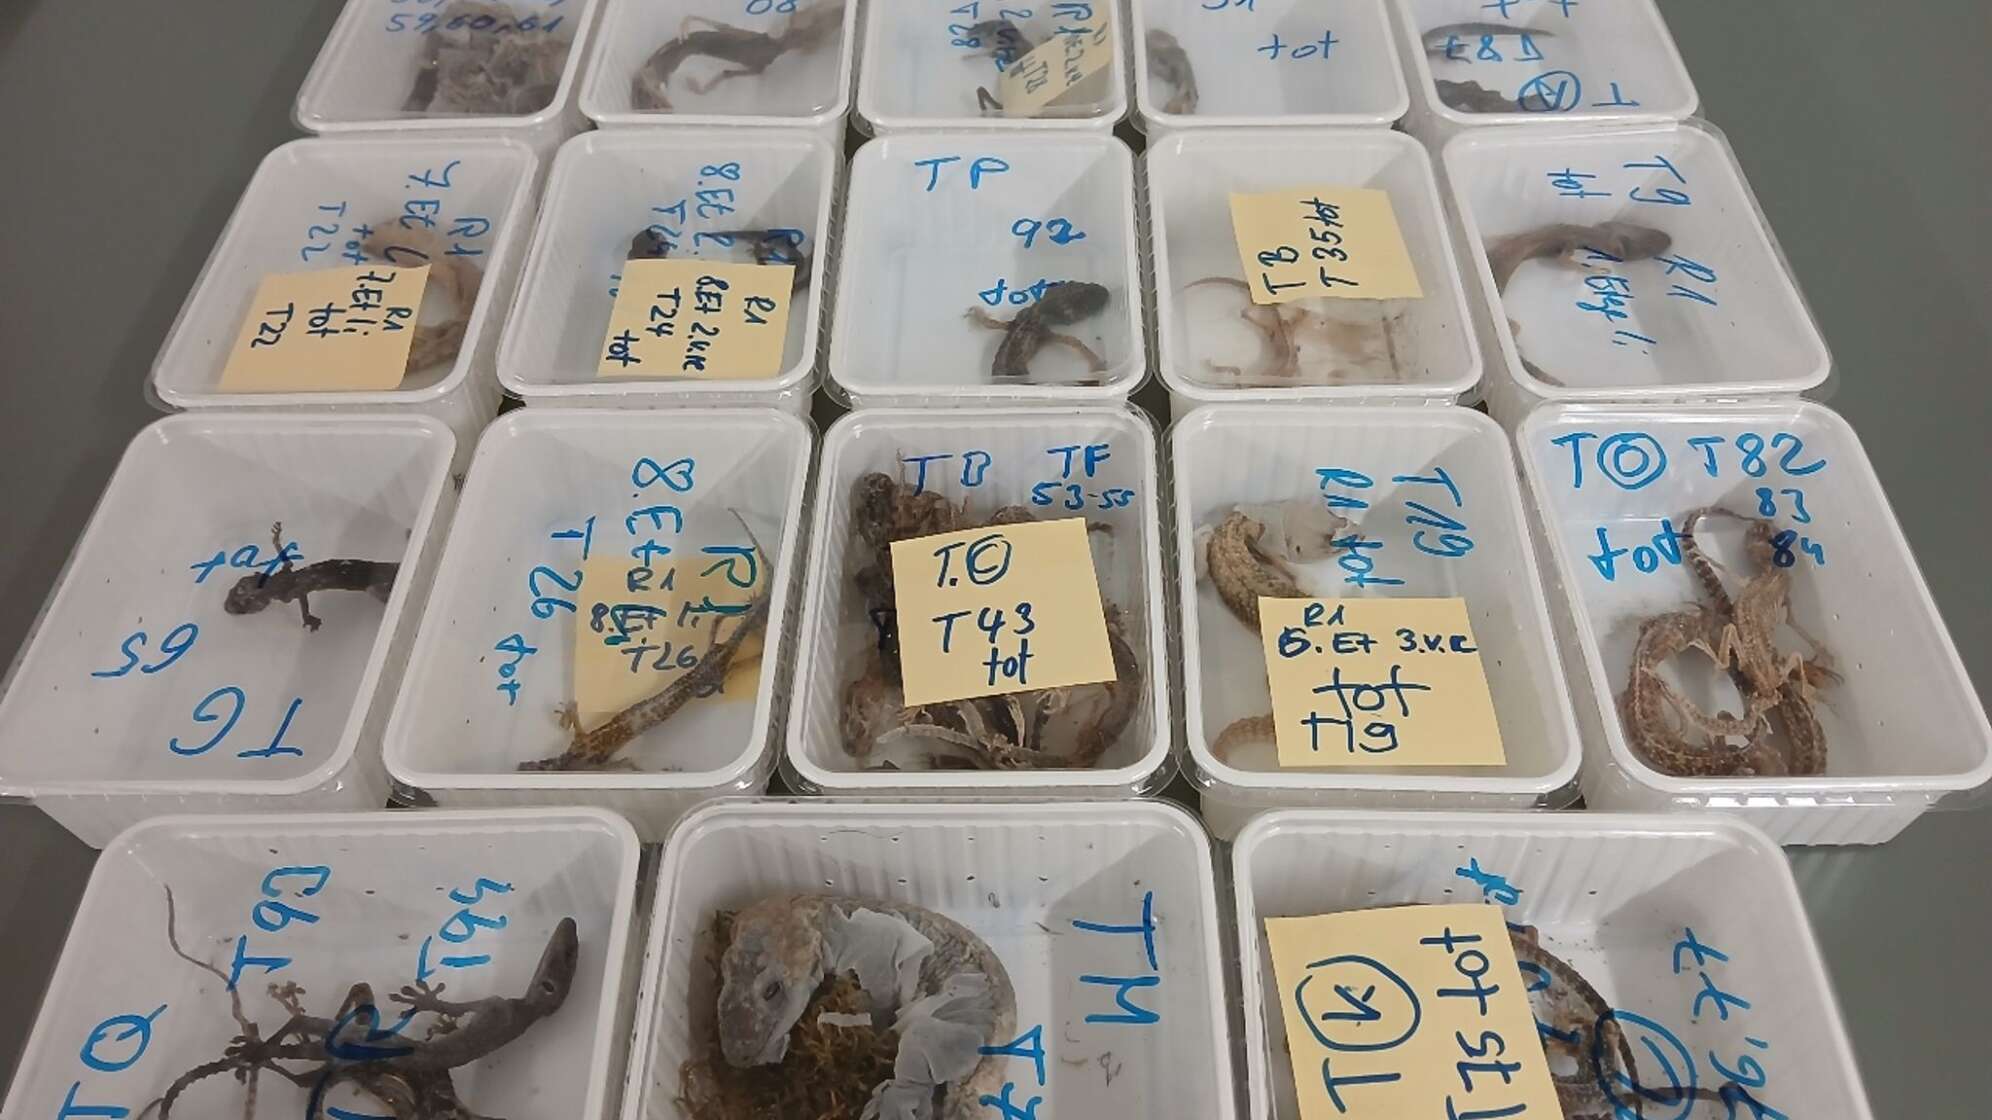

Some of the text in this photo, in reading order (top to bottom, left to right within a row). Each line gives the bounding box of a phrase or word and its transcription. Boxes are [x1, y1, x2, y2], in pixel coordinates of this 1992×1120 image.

[949, 2, 981, 49] T28
[1257, 30, 1339, 60] tot
[1547, 167, 1612, 198] tot
[301, 201, 346, 262] T22
[341, 223, 374, 265] tot
[444, 217, 490, 256] R1
[1011, 217, 1087, 248] 92
[645, 287, 681, 338] T24
[744, 295, 776, 325] R1
[978, 278, 1066, 306] tot
[251, 302, 294, 348] T22
[306, 302, 347, 338] tot
[382, 306, 413, 332] R1
[605, 329, 641, 368] tot
[1048, 444, 1111, 478] TF
[1392, 467, 1475, 558] T19
[1754, 487, 1812, 524] 83
[1315, 468, 1406, 588] R1 tot
[1769, 529, 1826, 568] 84
[190, 541, 305, 589] tot
[1588, 519, 1694, 582] tot
[627, 567, 675, 592] R1
[1304, 602, 1345, 627] R1
[91, 622, 199, 678] 65
[495, 633, 538, 706] tot
[982, 638, 1034, 686] tot
[1312, 664, 1432, 720] tot
[1300, 711, 1399, 753] T19
[1419, 926, 1500, 1016] tot
